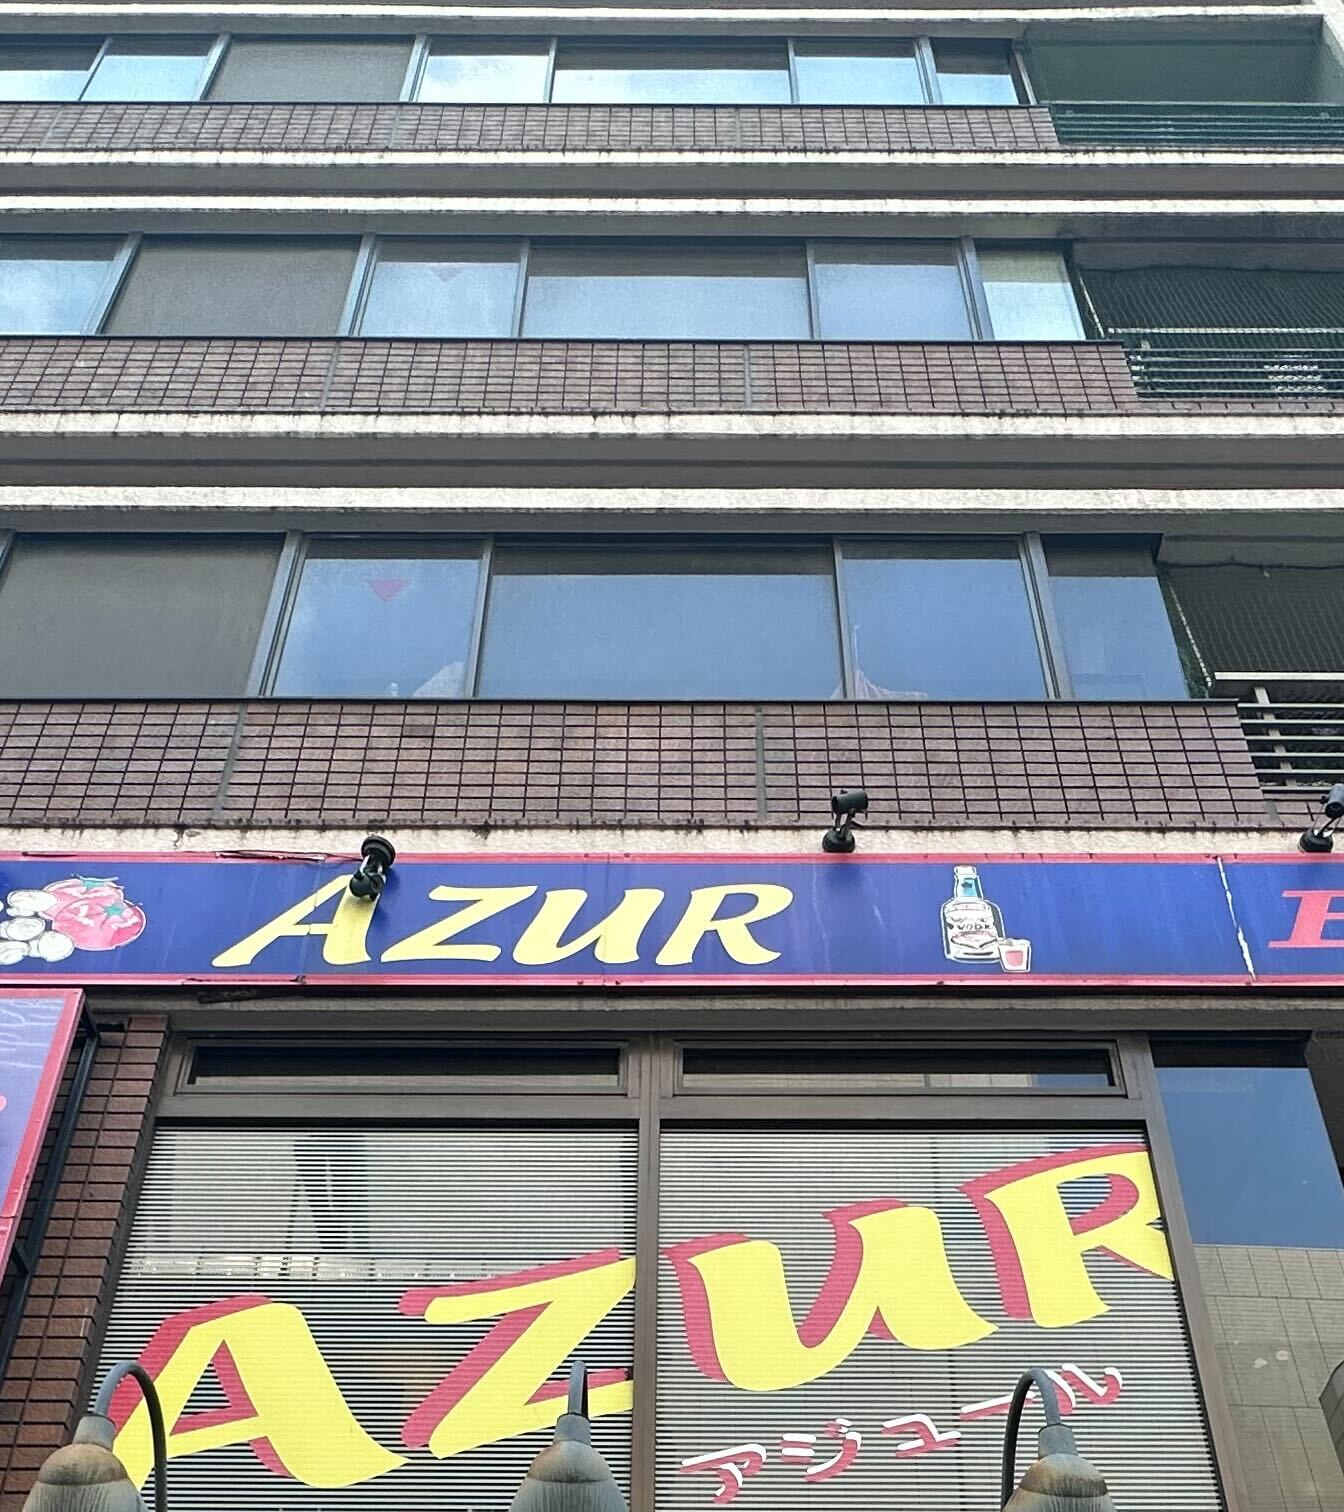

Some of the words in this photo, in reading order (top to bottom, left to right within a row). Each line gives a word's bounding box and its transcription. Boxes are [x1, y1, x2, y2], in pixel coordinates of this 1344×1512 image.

[211, 872, 794, 968] AZUR
[112, 1144, 1174, 1490] AZUR
[679, 1362, 1125, 1503] アジュール
